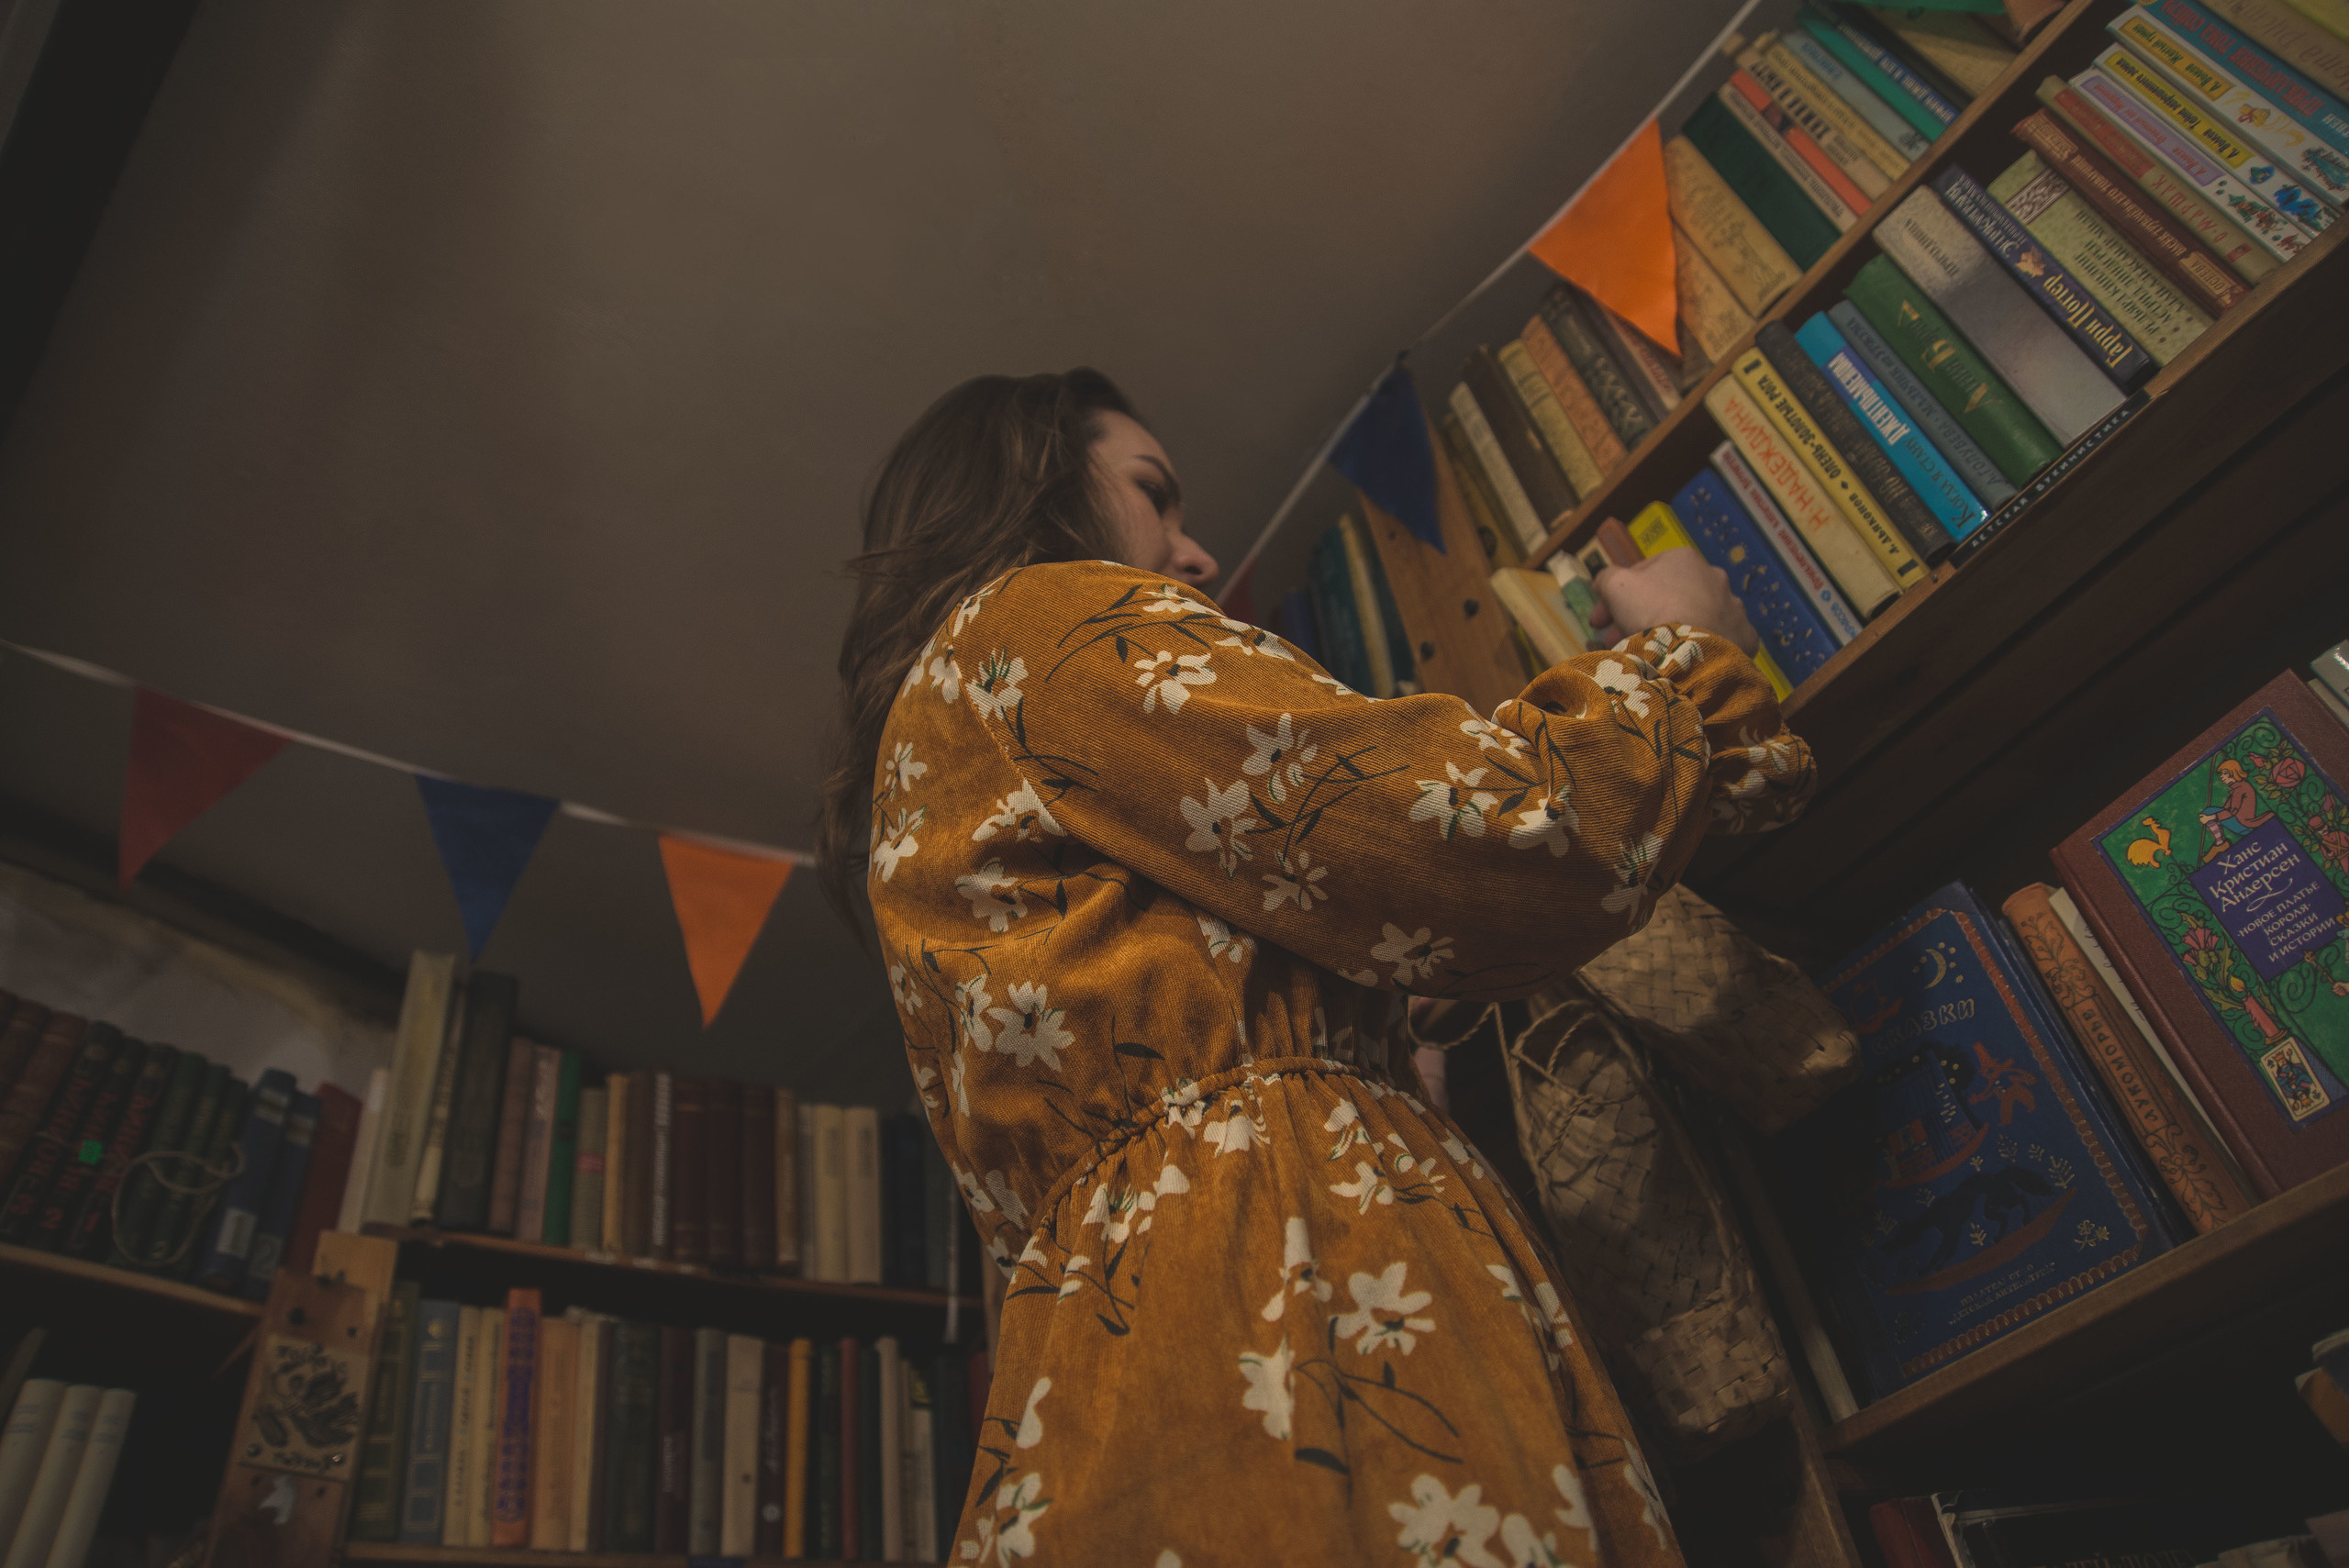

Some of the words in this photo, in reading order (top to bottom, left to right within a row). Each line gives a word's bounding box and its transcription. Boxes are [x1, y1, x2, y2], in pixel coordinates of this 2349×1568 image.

[2160, 0, 2207, 34] СОЙЕРА
[2197, 21, 2237, 55] ТОМА
[2182, 61, 2212, 87] Волков
[2226, 44, 2325, 116] ПРИКЛЮЧЕНИЯ
[2201, 126, 2231, 152] Волков
[2039, 273, 2093, 329] Поттер
[2081, 317, 2134, 370] Гарри
[1755, 373, 1783, 403] РОГА
[1825, 350, 1911, 447] ДЖЕНТЛЬМЕНОМ
[1720, 394, 1818, 514] НАДЕЖДИНА
[2034, 406, 2131, 493] БУКИНИСТИКА
[2208, 841, 2289, 899] Кристиан
[2216, 840, 2263, 875] Ханс
[2221, 852, 2301, 912] Андерсен
[2263, 903, 2311, 937] КОРОЛЯ
[2275, 880, 2321, 914] ПЛАТЬЕ
[2267, 911, 2320, 948] СКАЗКИ
[2267, 951, 2279, 962] И
[2277, 916, 2337, 956] ИСТОРИИ
[1872, 996, 1973, 1055] СКАЗКИ
[2082, 1006, 2159, 1126] ЛУКОМОРЬЕ
